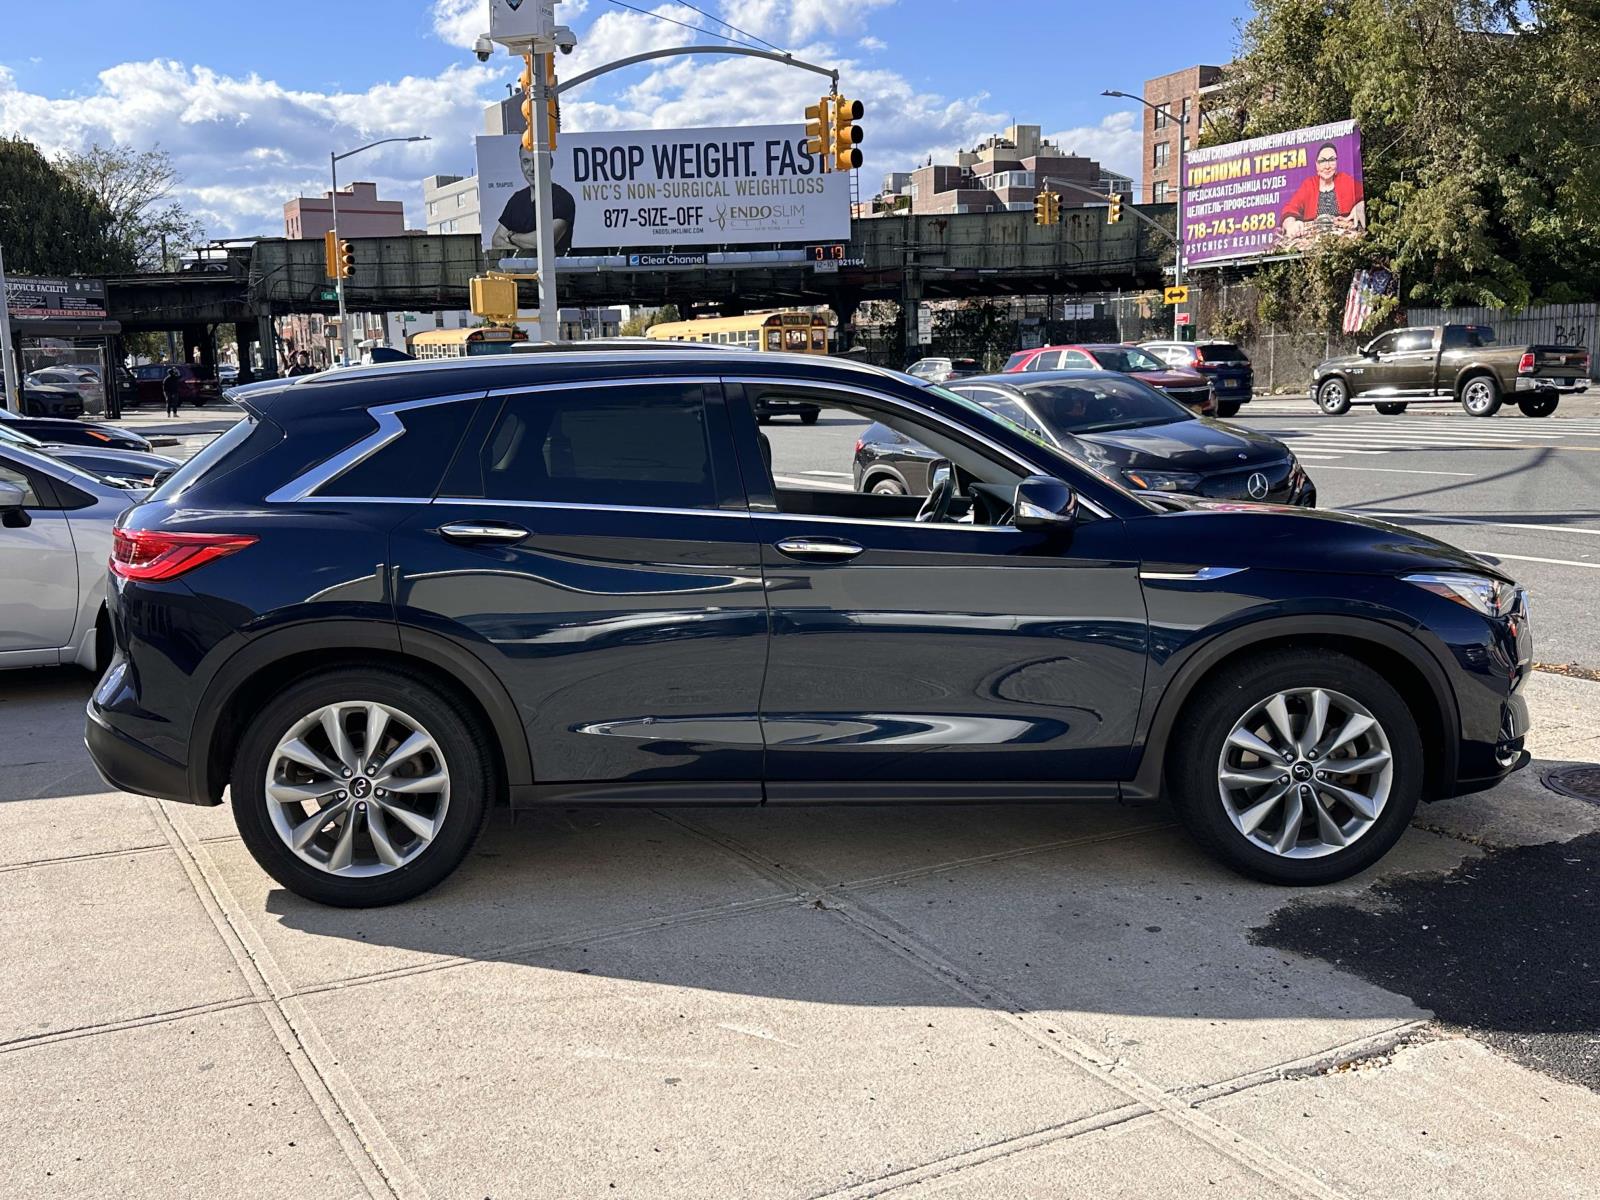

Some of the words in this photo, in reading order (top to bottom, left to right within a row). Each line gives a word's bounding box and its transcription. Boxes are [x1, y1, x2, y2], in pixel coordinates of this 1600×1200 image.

[1249, 131, 1296, 152] ЗНАМЕНИТАЯ
[572, 146, 645, 182] DROP
[651, 141, 757, 180] WEIGHT.
[1188, 157, 1251, 187] ГОСПОЖА
[1254, 147, 1307, 175] ТЕРЕЗА
[582, 184, 622, 201] NYC'S
[627, 180, 730, 200] NON-SURGICAL
[735, 177, 825, 197] WEIGHTLOSS
[1187, 178, 1261, 203] ПРЕДСКАЗАТЕЛЬНИЦА
[1262, 175, 1287, 191] СУДЕБ
[730, 204, 806, 219] ENDOSLIM
[1186, 191, 1280, 218] ЦЕЛИТЕЛЬ-ПРОФЕССИОНАЛ
[603, 206, 704, 228] 877-SIZE-OFF
[1186, 211, 1276, 241] 718-743-6828
[1232, 232, 1274, 248] READING
[641, 255, 666, 265] Clear
[666, 254, 705, 265] Channel
[36, 284, 69, 293] FACILITY
